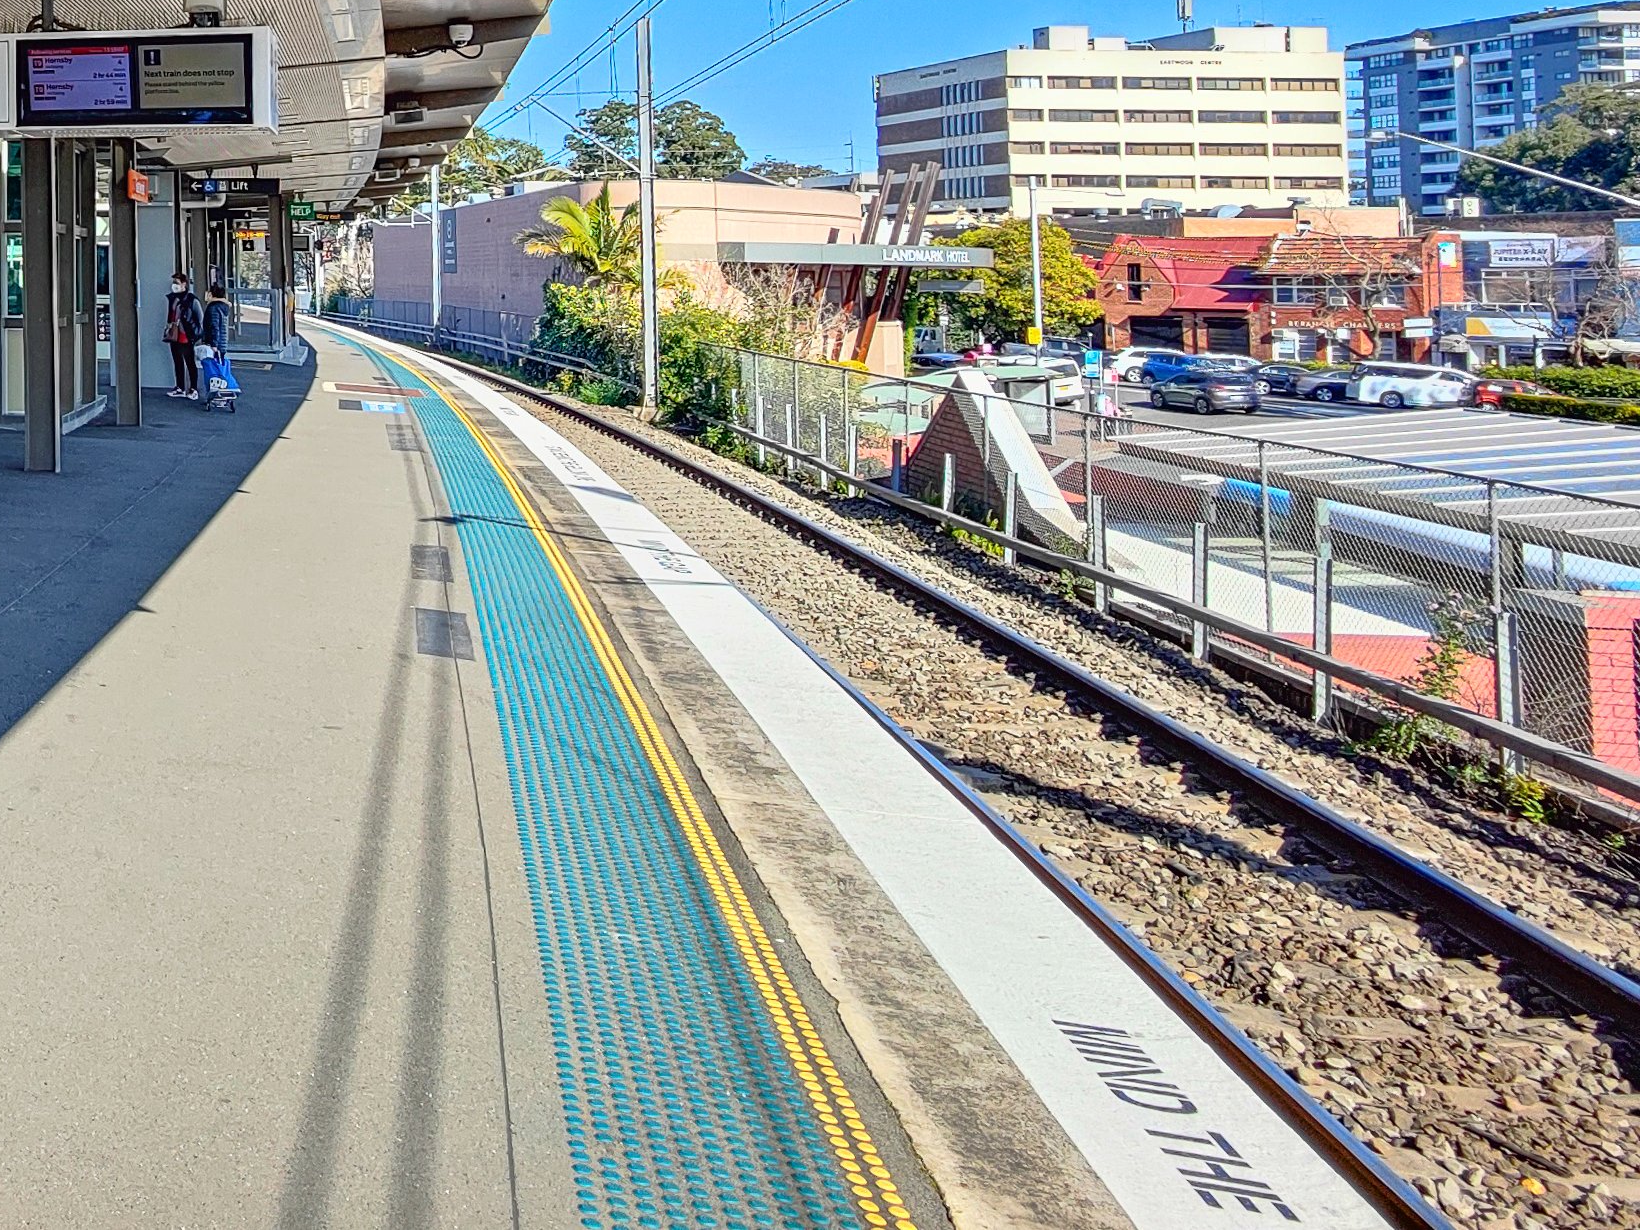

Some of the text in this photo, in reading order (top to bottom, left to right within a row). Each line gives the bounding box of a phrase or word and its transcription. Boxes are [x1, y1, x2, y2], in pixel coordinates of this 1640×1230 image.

[45, 57, 73, 65] Hornsby
[143, 69, 235, 78] Next train does not stop
[46, 83, 74, 91] Hornsby
[231, 181, 249, 191] Lift
[290, 208, 311, 216] HELP
[882, 248, 971, 263] LANDMARK HOTEL
[1342, 321, 1397, 330] CHAERS
[1051, 1019, 1301, 1223] MIND THE
